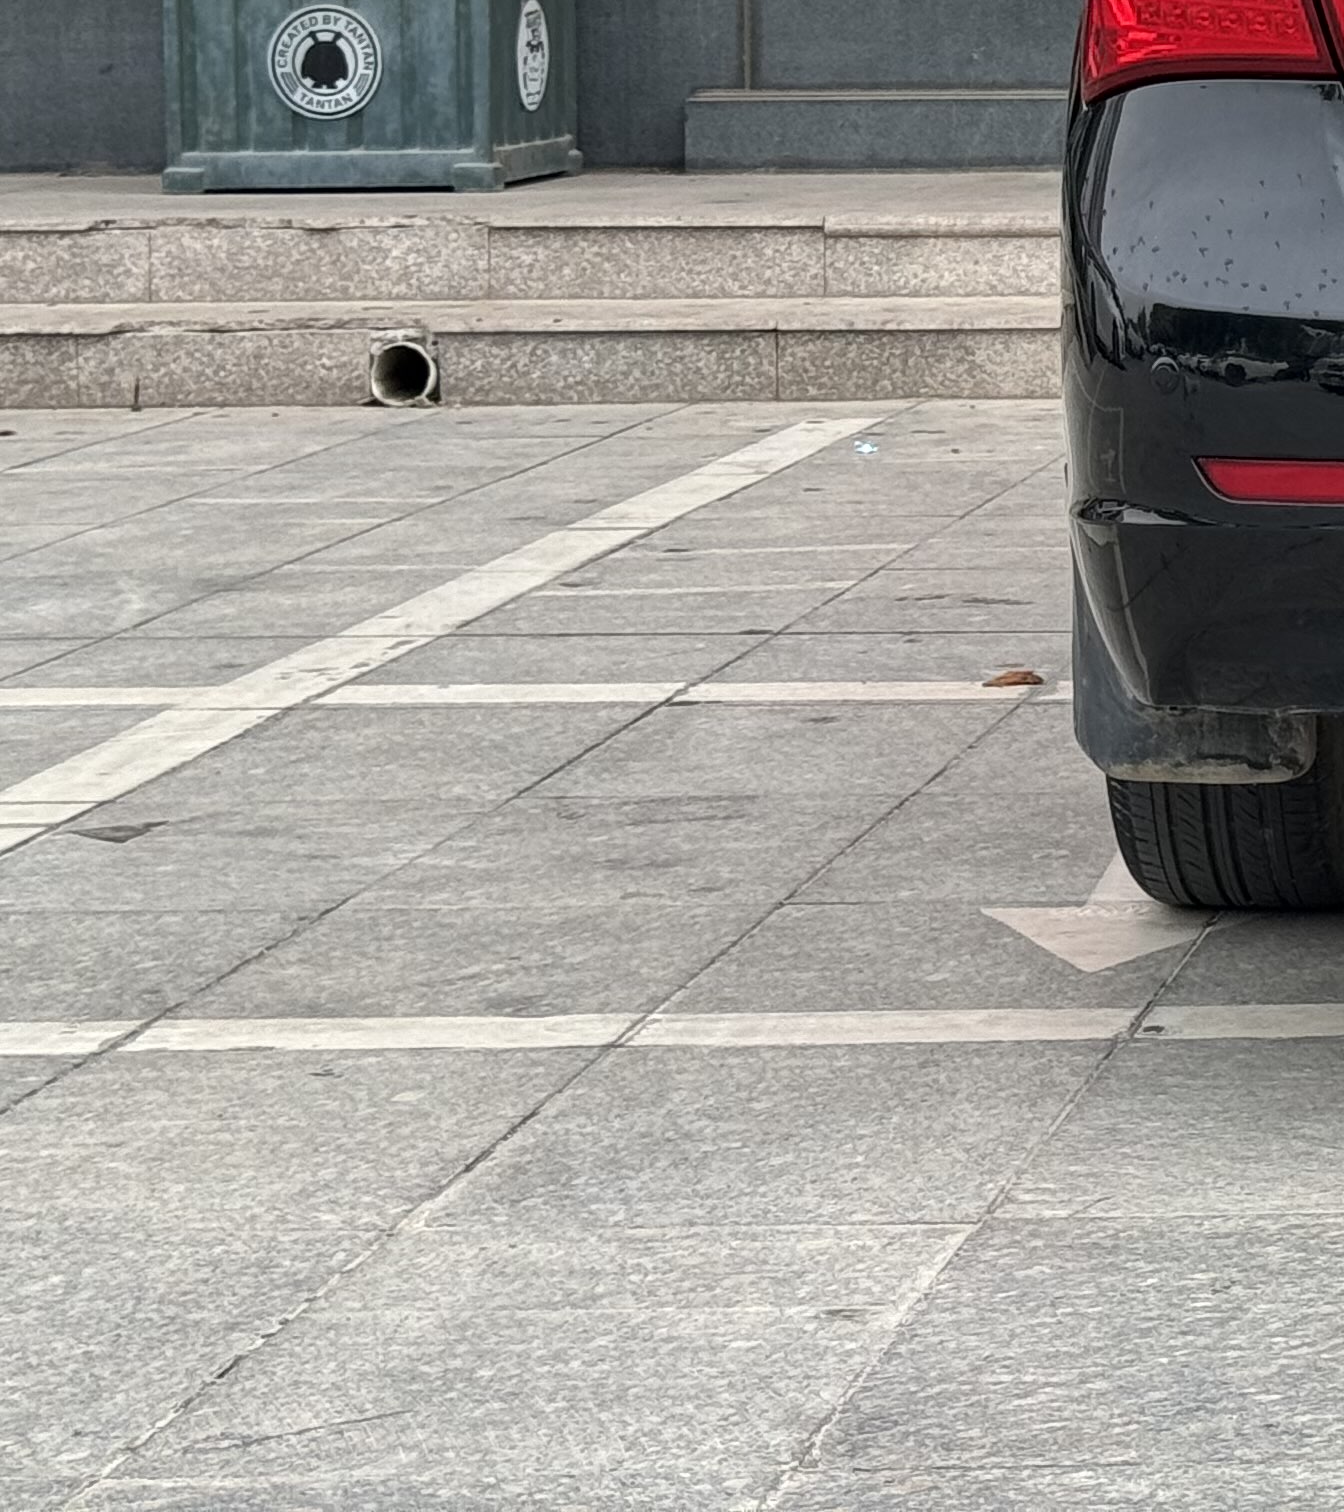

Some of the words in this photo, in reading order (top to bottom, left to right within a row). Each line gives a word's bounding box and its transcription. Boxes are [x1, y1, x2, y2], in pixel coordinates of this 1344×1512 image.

[277, 15, 319, 69] CREATED
[322, 14, 342, 27] BY
[343, 20, 375, 71] TANTAN
[299, 92, 354, 110] TANTAN
